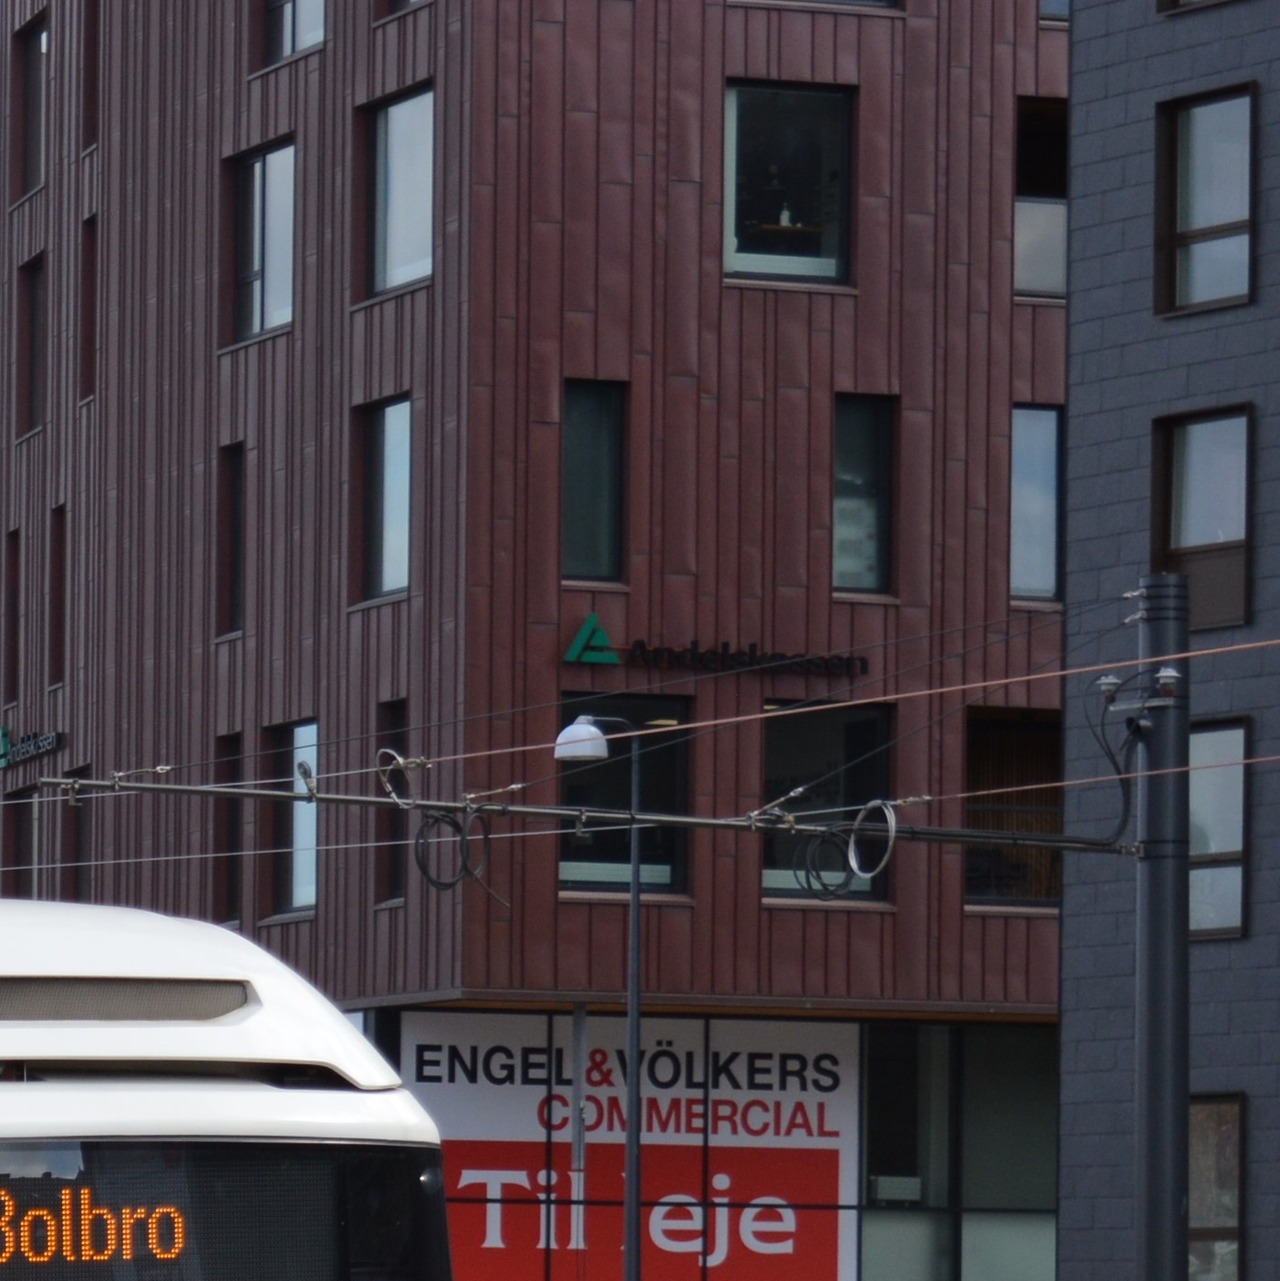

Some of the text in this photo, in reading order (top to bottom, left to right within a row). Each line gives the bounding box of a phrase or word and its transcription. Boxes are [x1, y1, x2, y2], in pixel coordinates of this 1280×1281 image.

[537, 1094, 840, 1138] COMMERCIAL
[457, 1169, 796, 1267] Til eje
